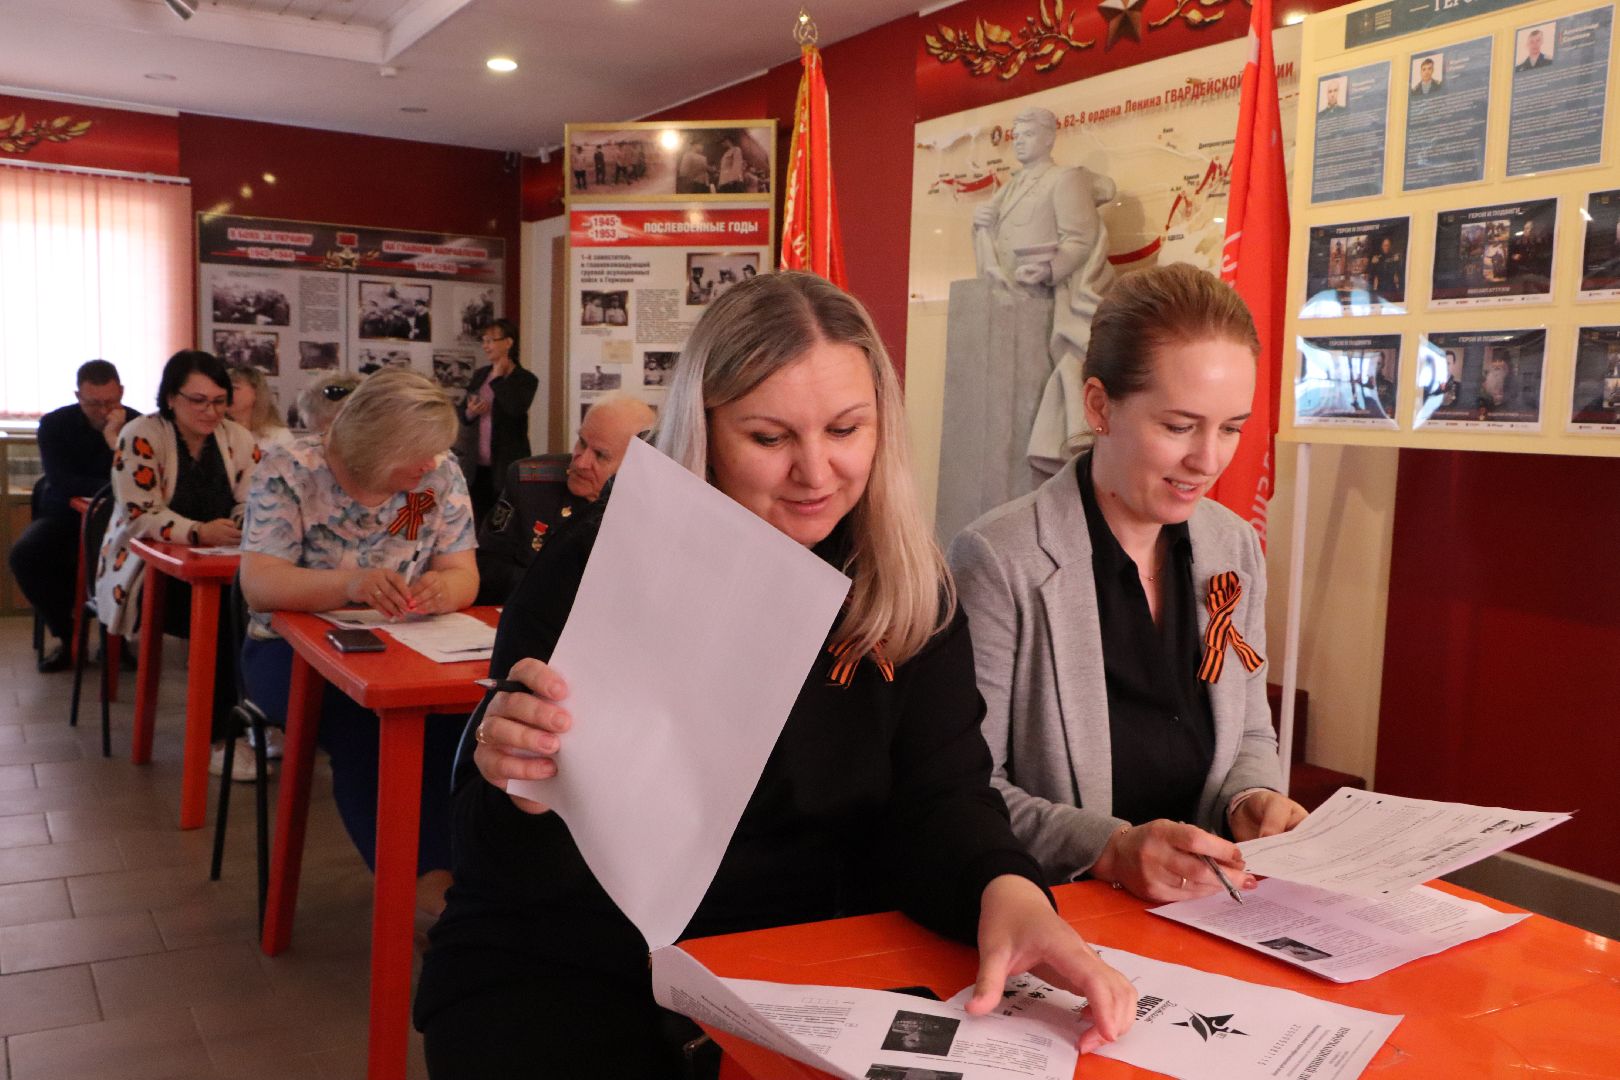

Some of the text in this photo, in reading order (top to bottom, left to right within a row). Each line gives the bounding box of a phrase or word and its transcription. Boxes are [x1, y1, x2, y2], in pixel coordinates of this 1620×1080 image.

[1088, 105, 1121, 123] ордена
[1124, 96, 1161, 113] Ленина
[643, 220, 759, 234] ПОСЛЕВОЕННЫЕ ГОДЫ
